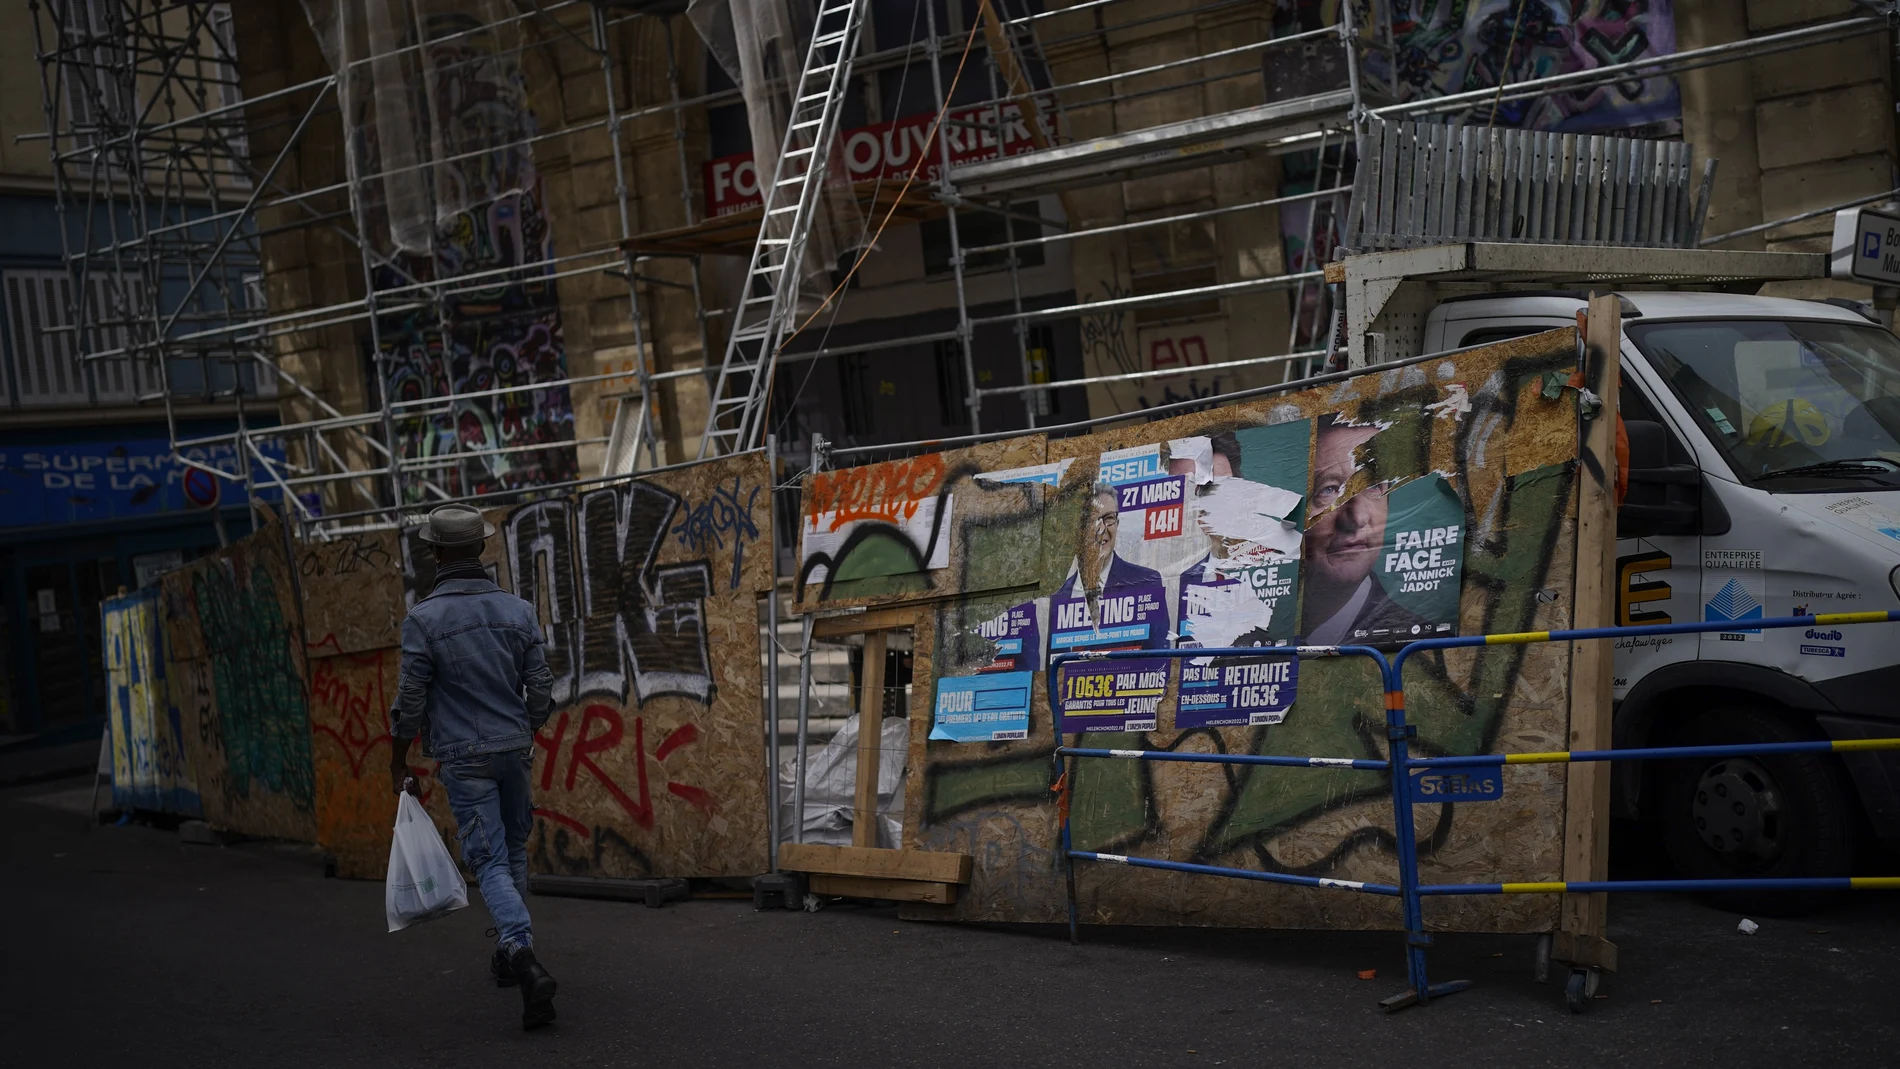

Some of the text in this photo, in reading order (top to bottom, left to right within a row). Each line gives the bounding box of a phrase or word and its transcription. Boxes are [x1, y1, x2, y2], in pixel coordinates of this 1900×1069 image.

[43, 472, 95, 489] DE
[109, 472, 154, 490] LA
[1122, 482, 1181, 508] 27 MARS
[1149, 507, 1180, 534] 14H
[1395, 525, 1459, 551] FAIRE
[1385, 548, 1442, 573] FACE
[1705, 551, 1761, 560] ENTREPRISE
[1403, 566, 1454, 581] YANNICK
[1400, 580, 1440, 593] JADOT
[1615, 550, 1672, 627] E
[1138, 594, 1152, 603] PLAGE
[1793, 590, 1833, 599] Distributeur
[1836, 591, 1857, 600] Agrée
[1138, 602, 1160, 612] DU PRADO
[1137, 612, 1147, 621] SUD
[1805, 629, 1842, 641] duarib
[1803, 646, 1830, 655] TUBESCA
[1116, 673, 1137, 690] PAR
[1139, 671, 1167, 689] MOIS
[1183, 661, 1291, 686] PAS UNE RETRAITE
[939, 690, 973, 713] POUR
[1065, 699, 1092, 710] GARANTIS
[1093, 700, 1105, 708] POUR
[1106, 699, 1117, 707] TOUS
[1117, 698, 1125, 706] LES
[1181, 693, 1220, 705] EN-DESSOUS
